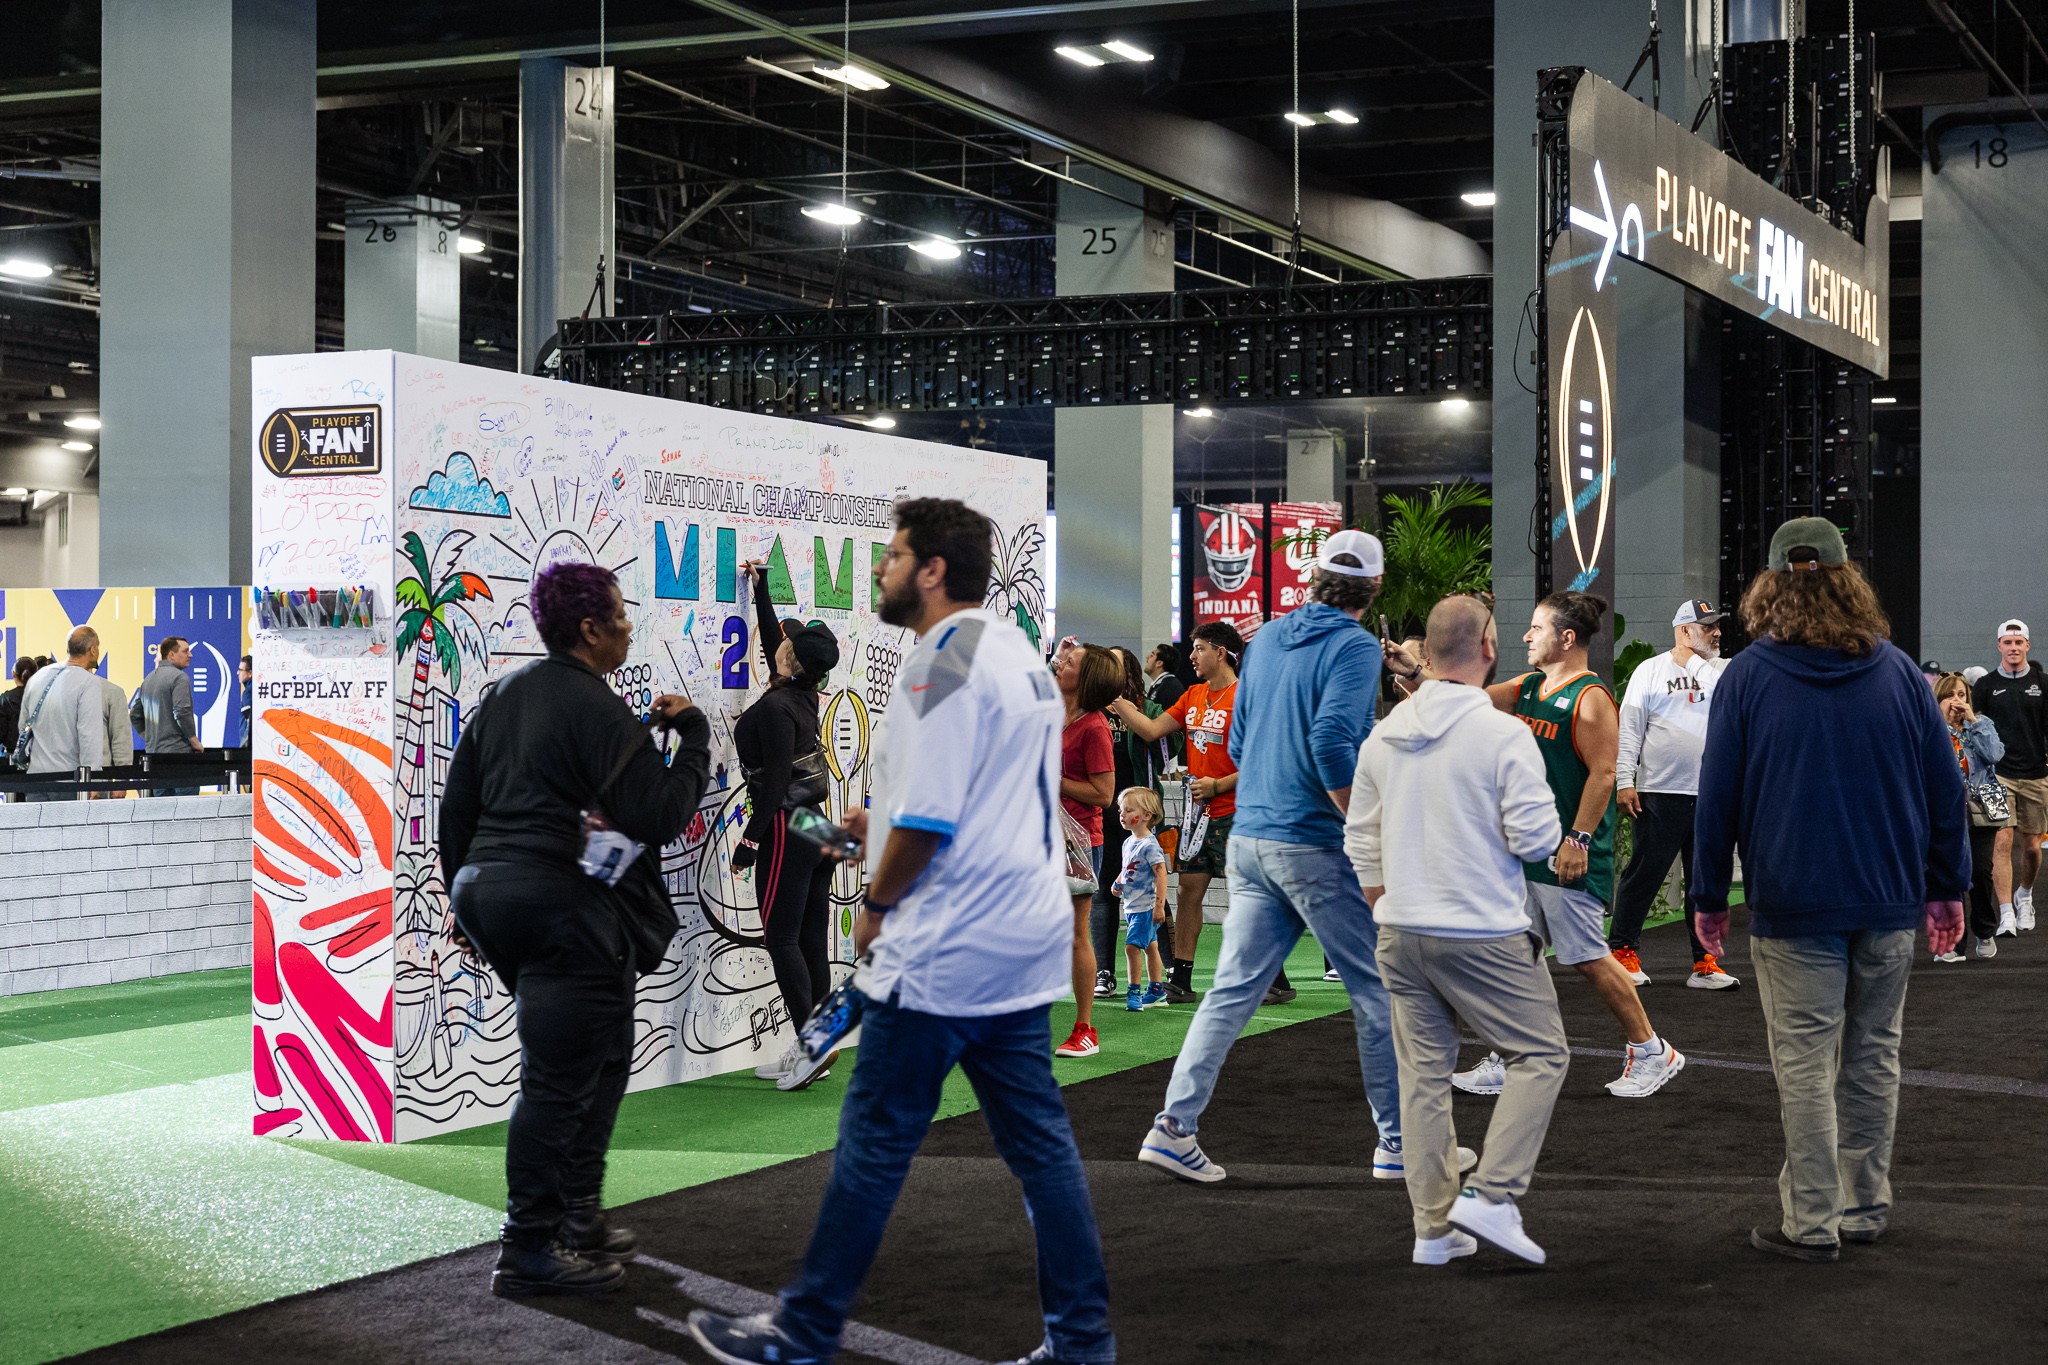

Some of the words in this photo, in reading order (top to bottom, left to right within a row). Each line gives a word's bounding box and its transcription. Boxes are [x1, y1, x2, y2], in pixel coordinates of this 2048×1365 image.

[575, 77, 602, 120] 24
[1968, 138, 2008, 169] 18
[1082, 227, 1117, 255] 25
[1656, 166, 1752, 276] PLAYOFF
[1757, 217, 1803, 319] FAN
[1808, 258, 1880, 346] CENTRAL
[313, 417, 360, 427] PLAYOFF
[309, 427, 363, 454] FAN
[1301, 441, 1319, 455] 27
[313, 455, 360, 465] CENTRAL
[644, 470, 749, 514] NATIONAL
[655, 520, 889, 614] MIAMI
[1199, 600, 1260, 624] INDIANA
[1667, 676, 1702, 695] MIA
